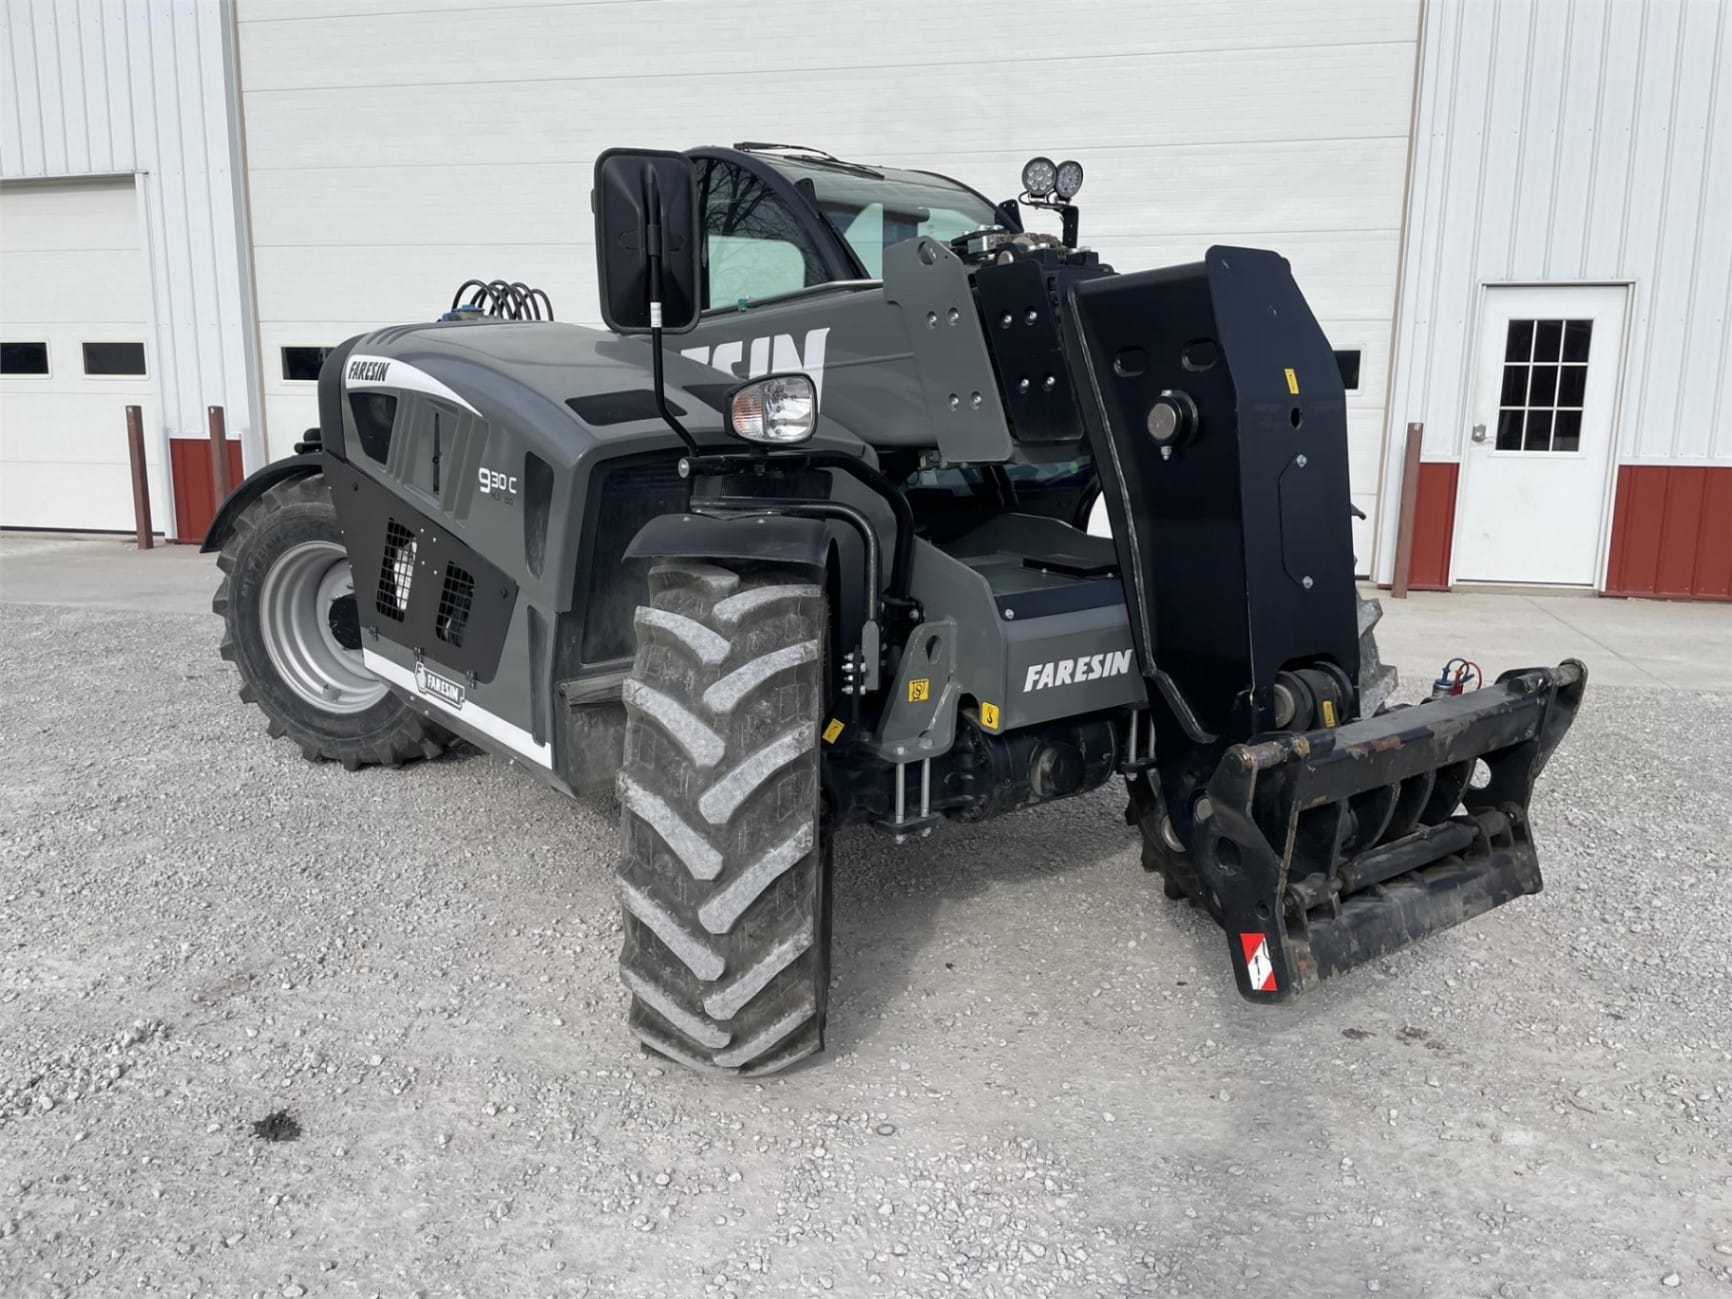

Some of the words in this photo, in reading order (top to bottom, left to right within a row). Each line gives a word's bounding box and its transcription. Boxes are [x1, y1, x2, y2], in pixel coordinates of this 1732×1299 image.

[348, 361, 391, 381] FARESIN
[1023, 648, 1133, 693] FARESIN
[427, 673, 459, 701] FARESIN
